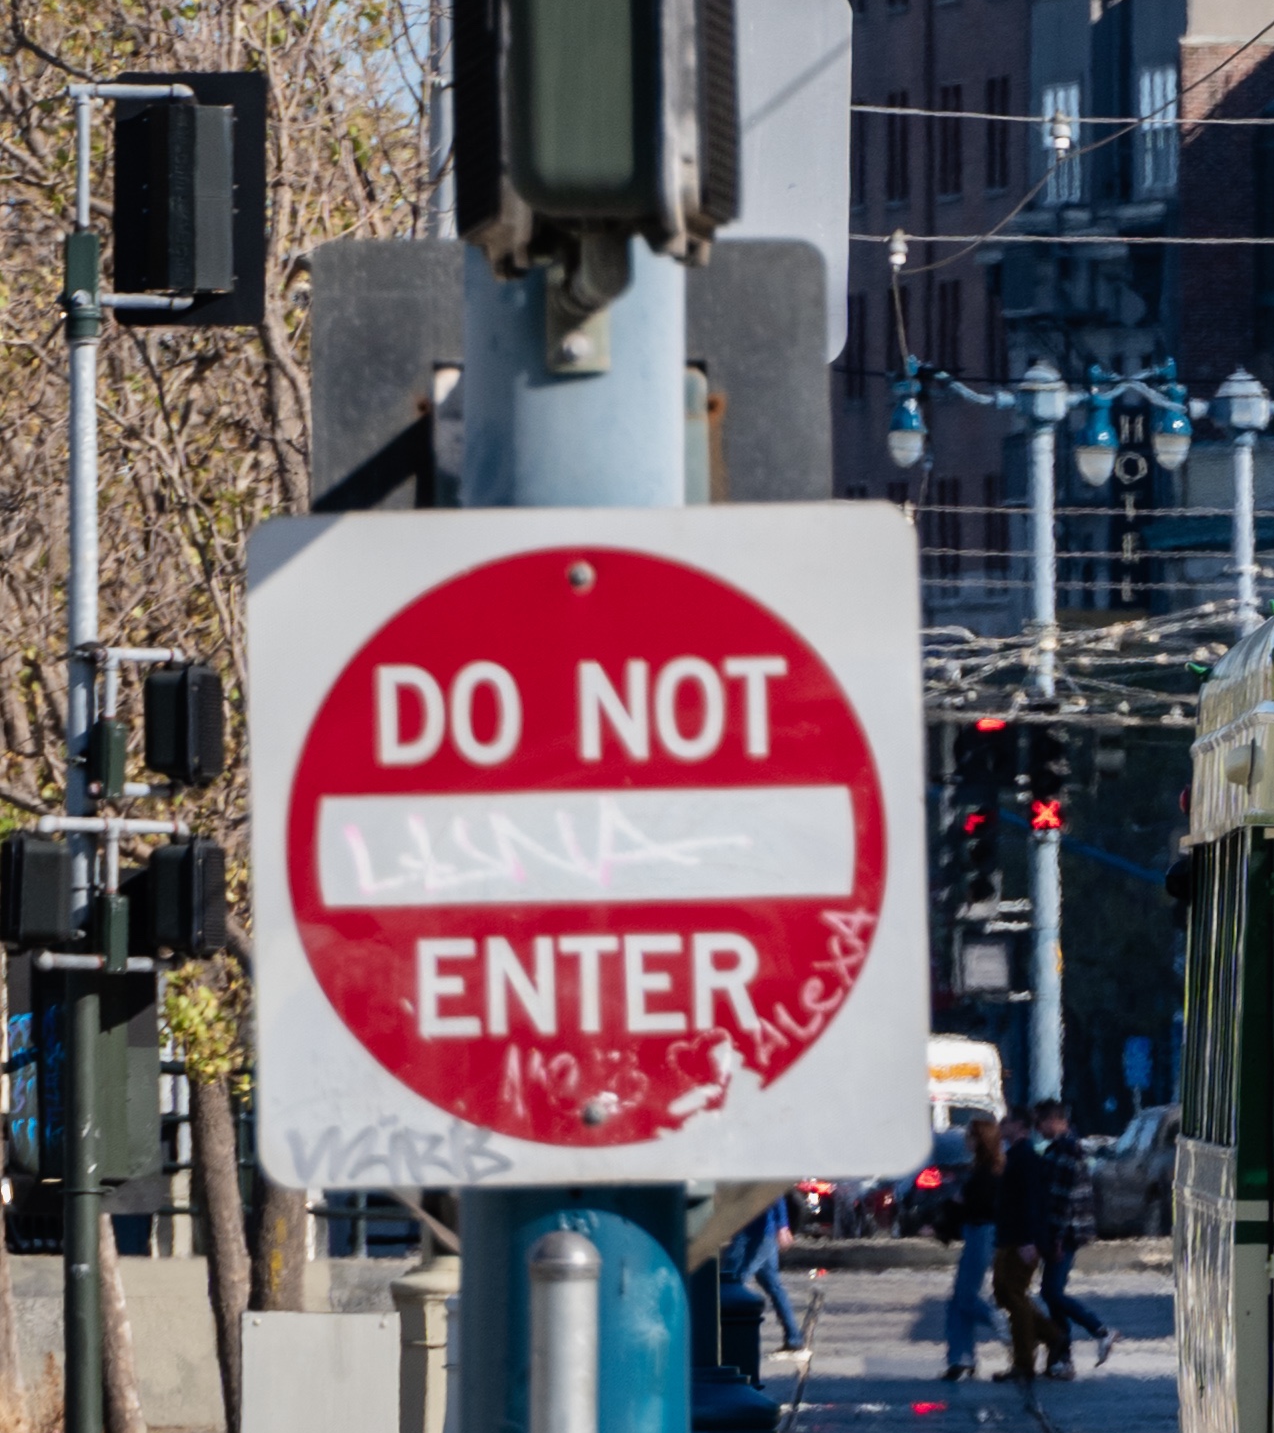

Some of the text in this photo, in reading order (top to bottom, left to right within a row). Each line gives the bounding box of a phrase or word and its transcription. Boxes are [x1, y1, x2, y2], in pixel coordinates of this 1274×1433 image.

[374, 655, 788, 767] DO NOT
[415, 932, 760, 1038] ENTER
